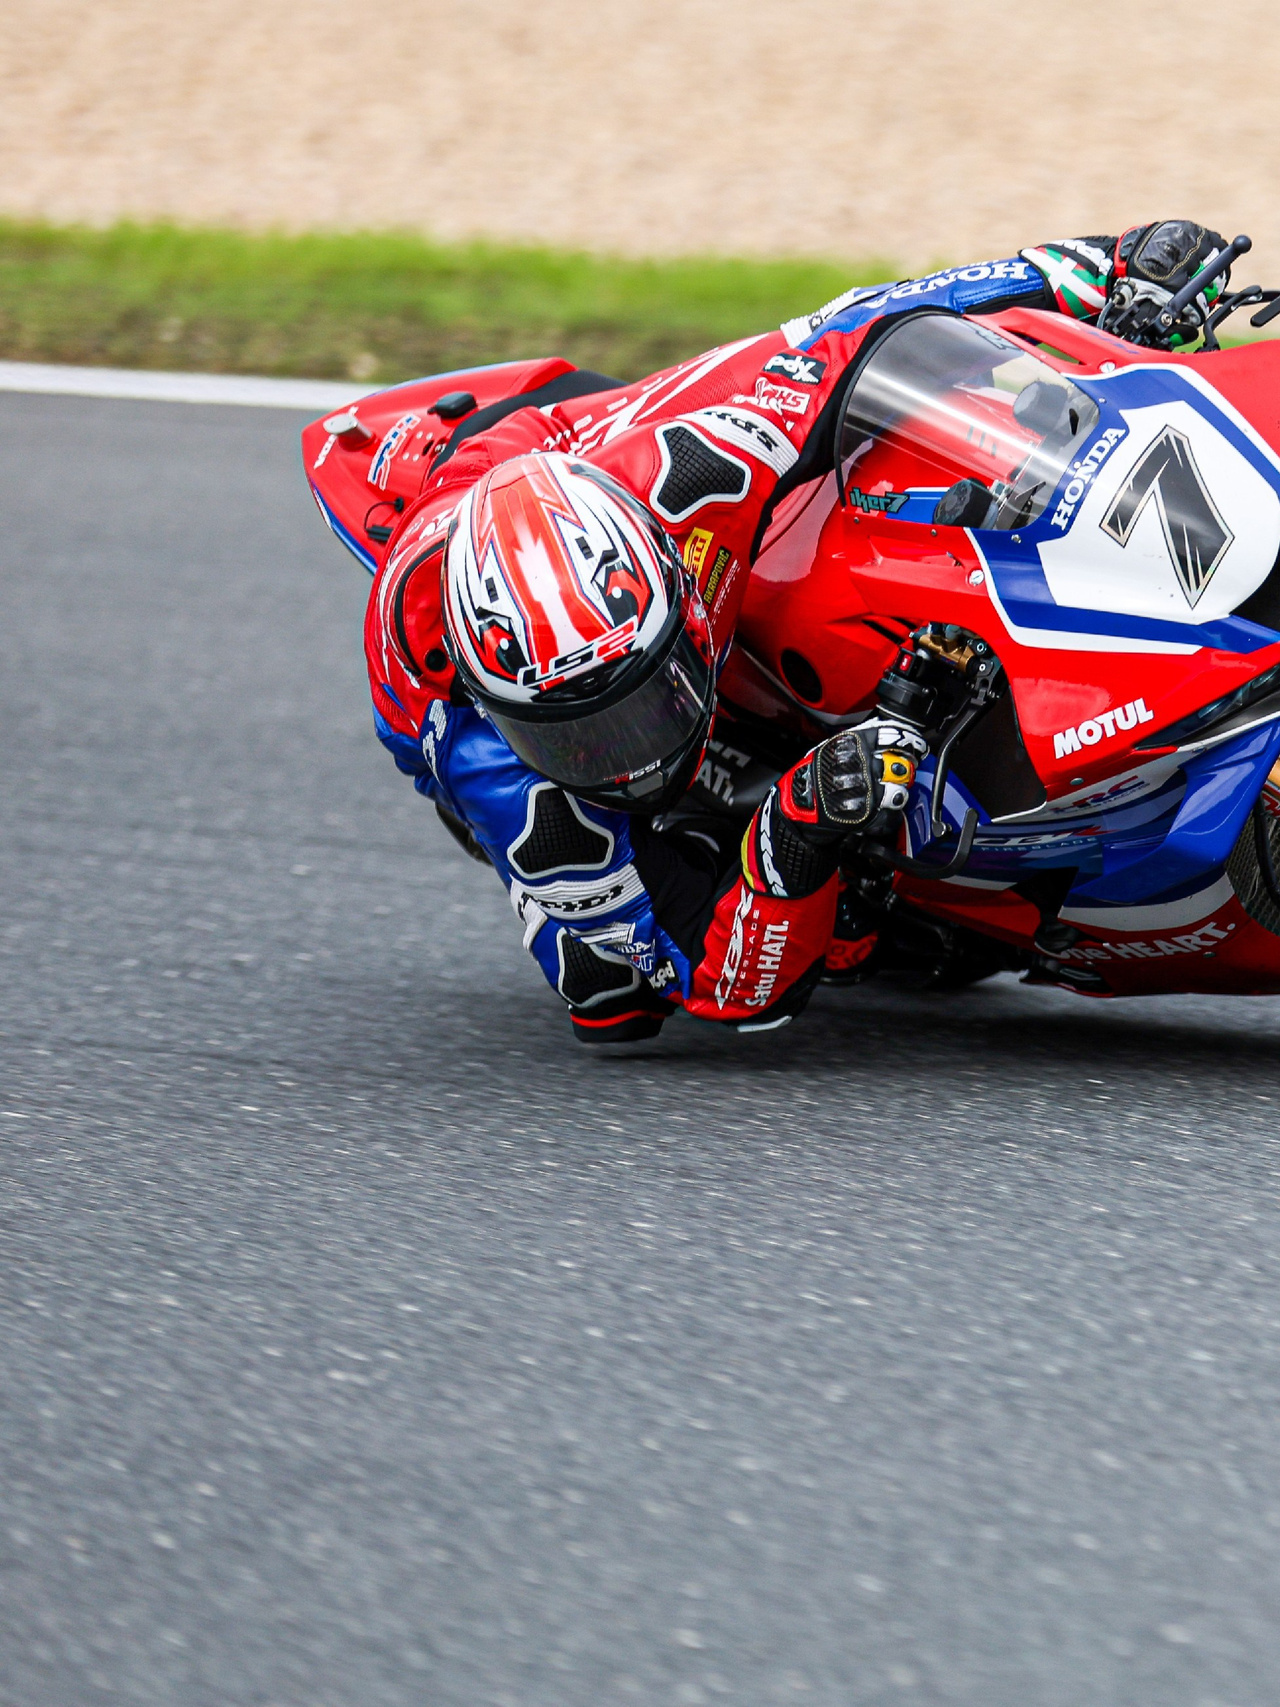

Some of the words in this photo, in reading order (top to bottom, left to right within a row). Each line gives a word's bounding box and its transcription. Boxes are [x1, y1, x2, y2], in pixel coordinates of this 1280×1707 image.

[862, 261, 1029, 308] HONDA
[850, 487, 910, 514] iker7
[1050, 427, 1127, 531] HONDA
[1098, 424, 1236, 611] 7
[517, 614, 640, 688] LS2
[1053, 697, 1154, 760] MOTUL
[697, 758, 735, 807] ATI.
[757, 920, 789, 971] HATI.
[1102, 921, 1236, 960] HEART.
[744, 972, 777, 1007] Satu
